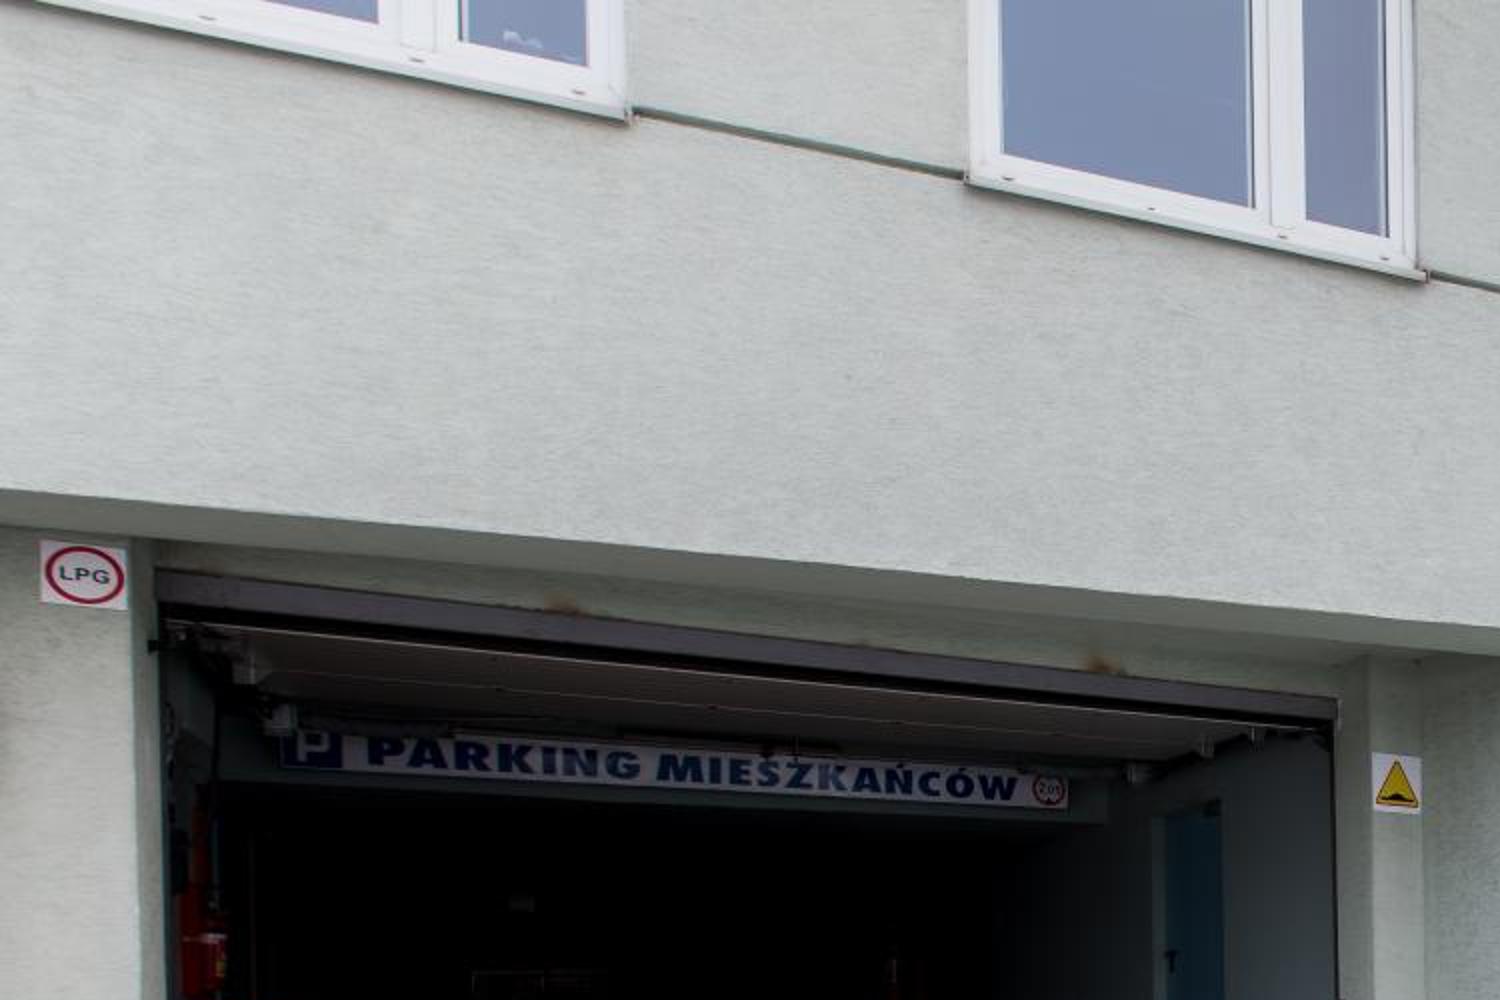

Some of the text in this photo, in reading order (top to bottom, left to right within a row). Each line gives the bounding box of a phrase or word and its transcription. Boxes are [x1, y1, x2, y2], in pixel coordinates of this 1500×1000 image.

[59, 565, 110, 585] LPG
[366, 734, 641, 779] PARKING
[657, 752, 1017, 800] MIESZKAŃCÓW
